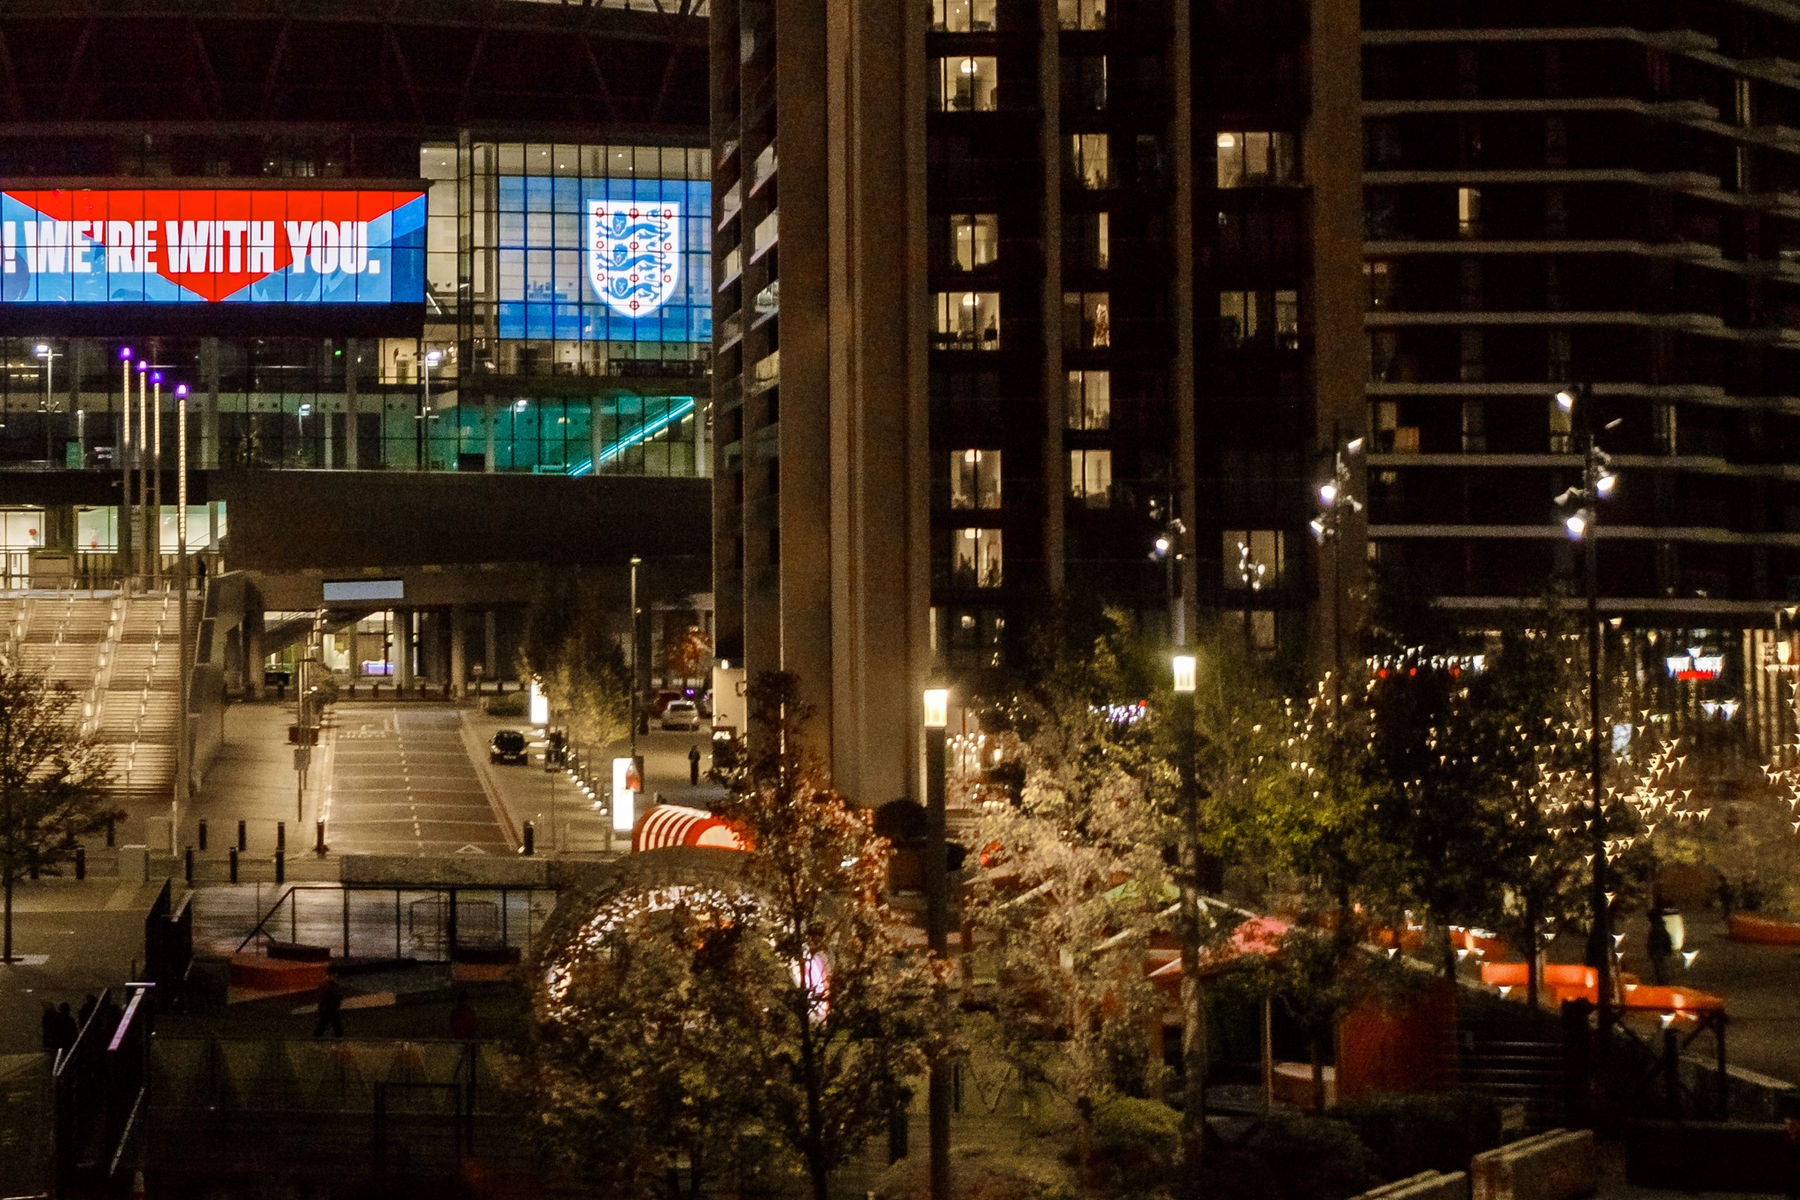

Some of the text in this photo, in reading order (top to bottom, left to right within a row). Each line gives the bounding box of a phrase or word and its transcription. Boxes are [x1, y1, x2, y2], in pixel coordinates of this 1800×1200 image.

[24, 220, 157, 273] WE'RE
[165, 220, 275, 273] WITH
[284, 220, 380, 275] YOU.
